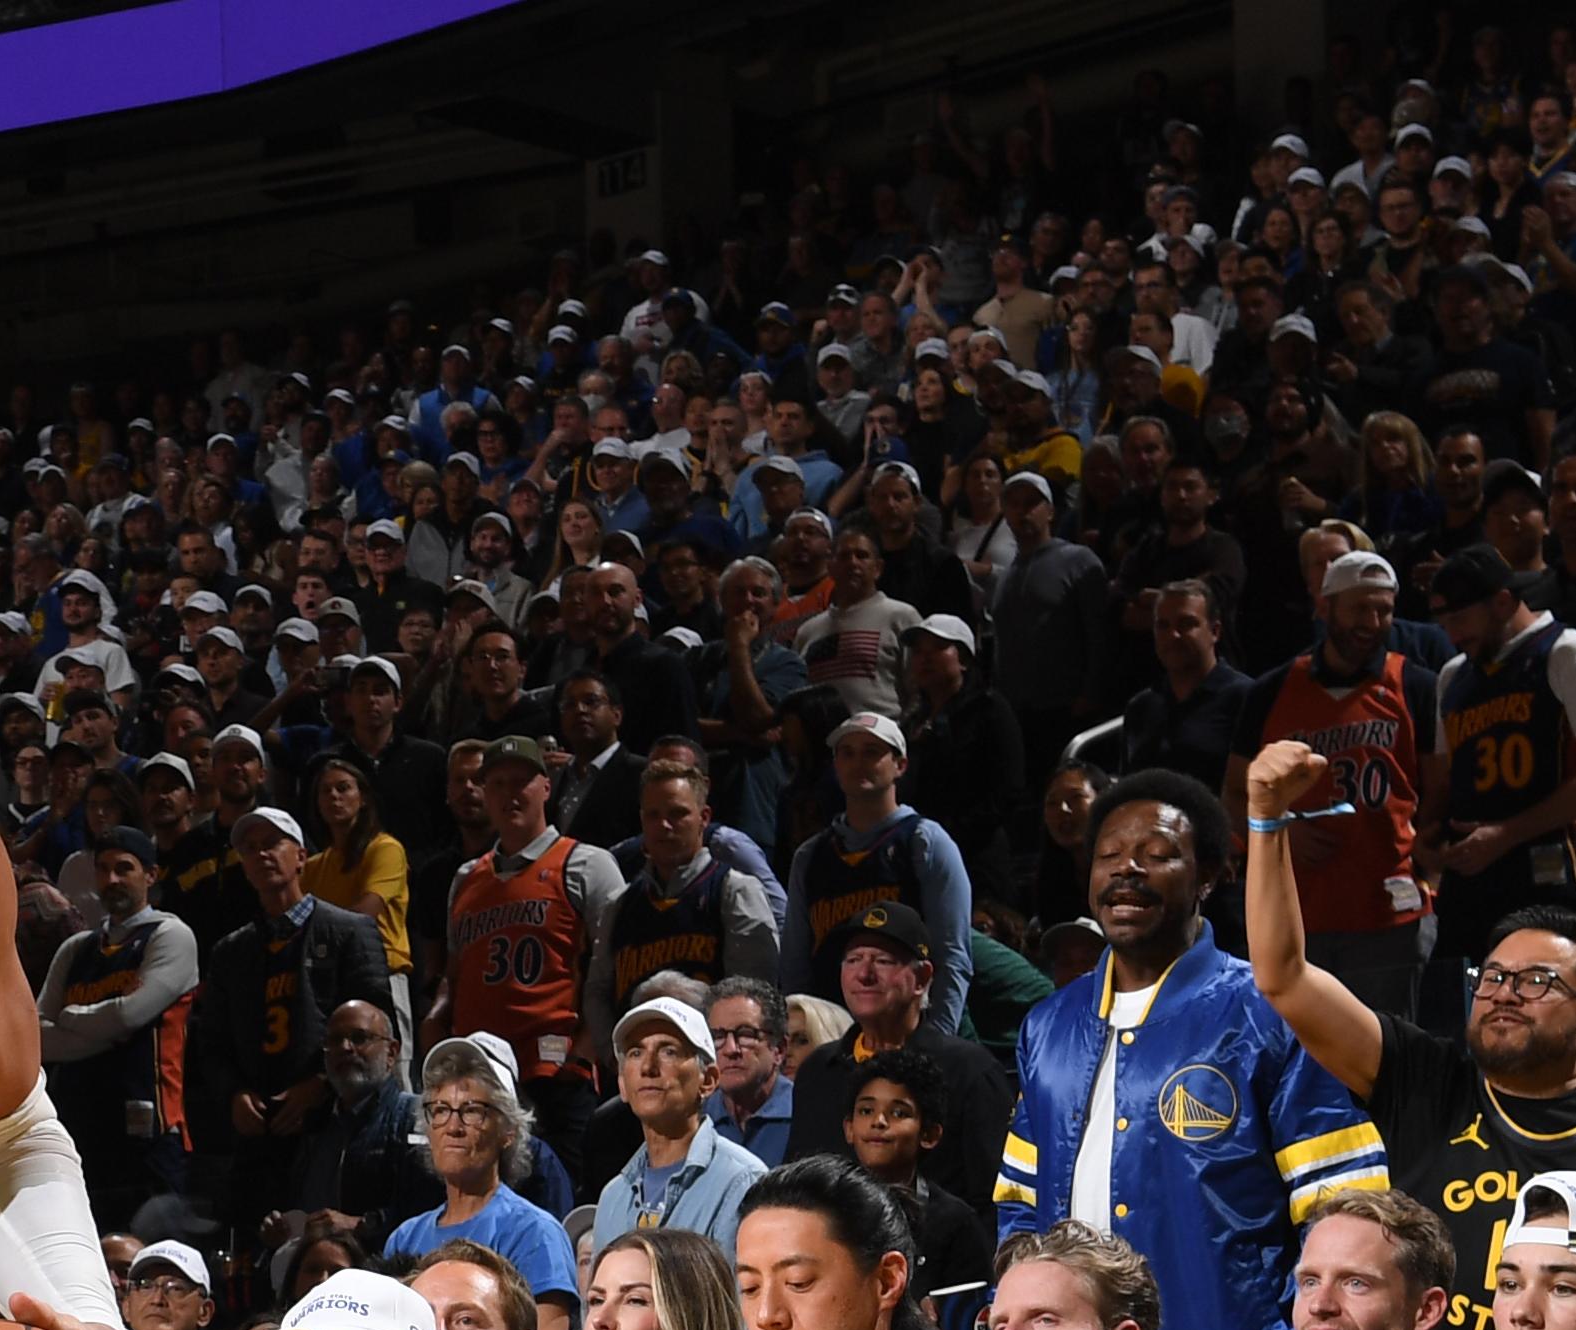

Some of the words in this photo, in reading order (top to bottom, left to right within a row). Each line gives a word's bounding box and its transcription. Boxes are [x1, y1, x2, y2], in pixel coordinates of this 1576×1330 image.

[1295, 718, 1399, 756] RRIORS
[1474, 732, 1536, 793] 30
[1331, 756, 1390, 811] 30
[482, 934, 544, 987] 30
[262, 1005, 292, 1056] 3
[1443, 1171, 1519, 1213] GOL
[290, 1299, 370, 1328] WARRIORS
